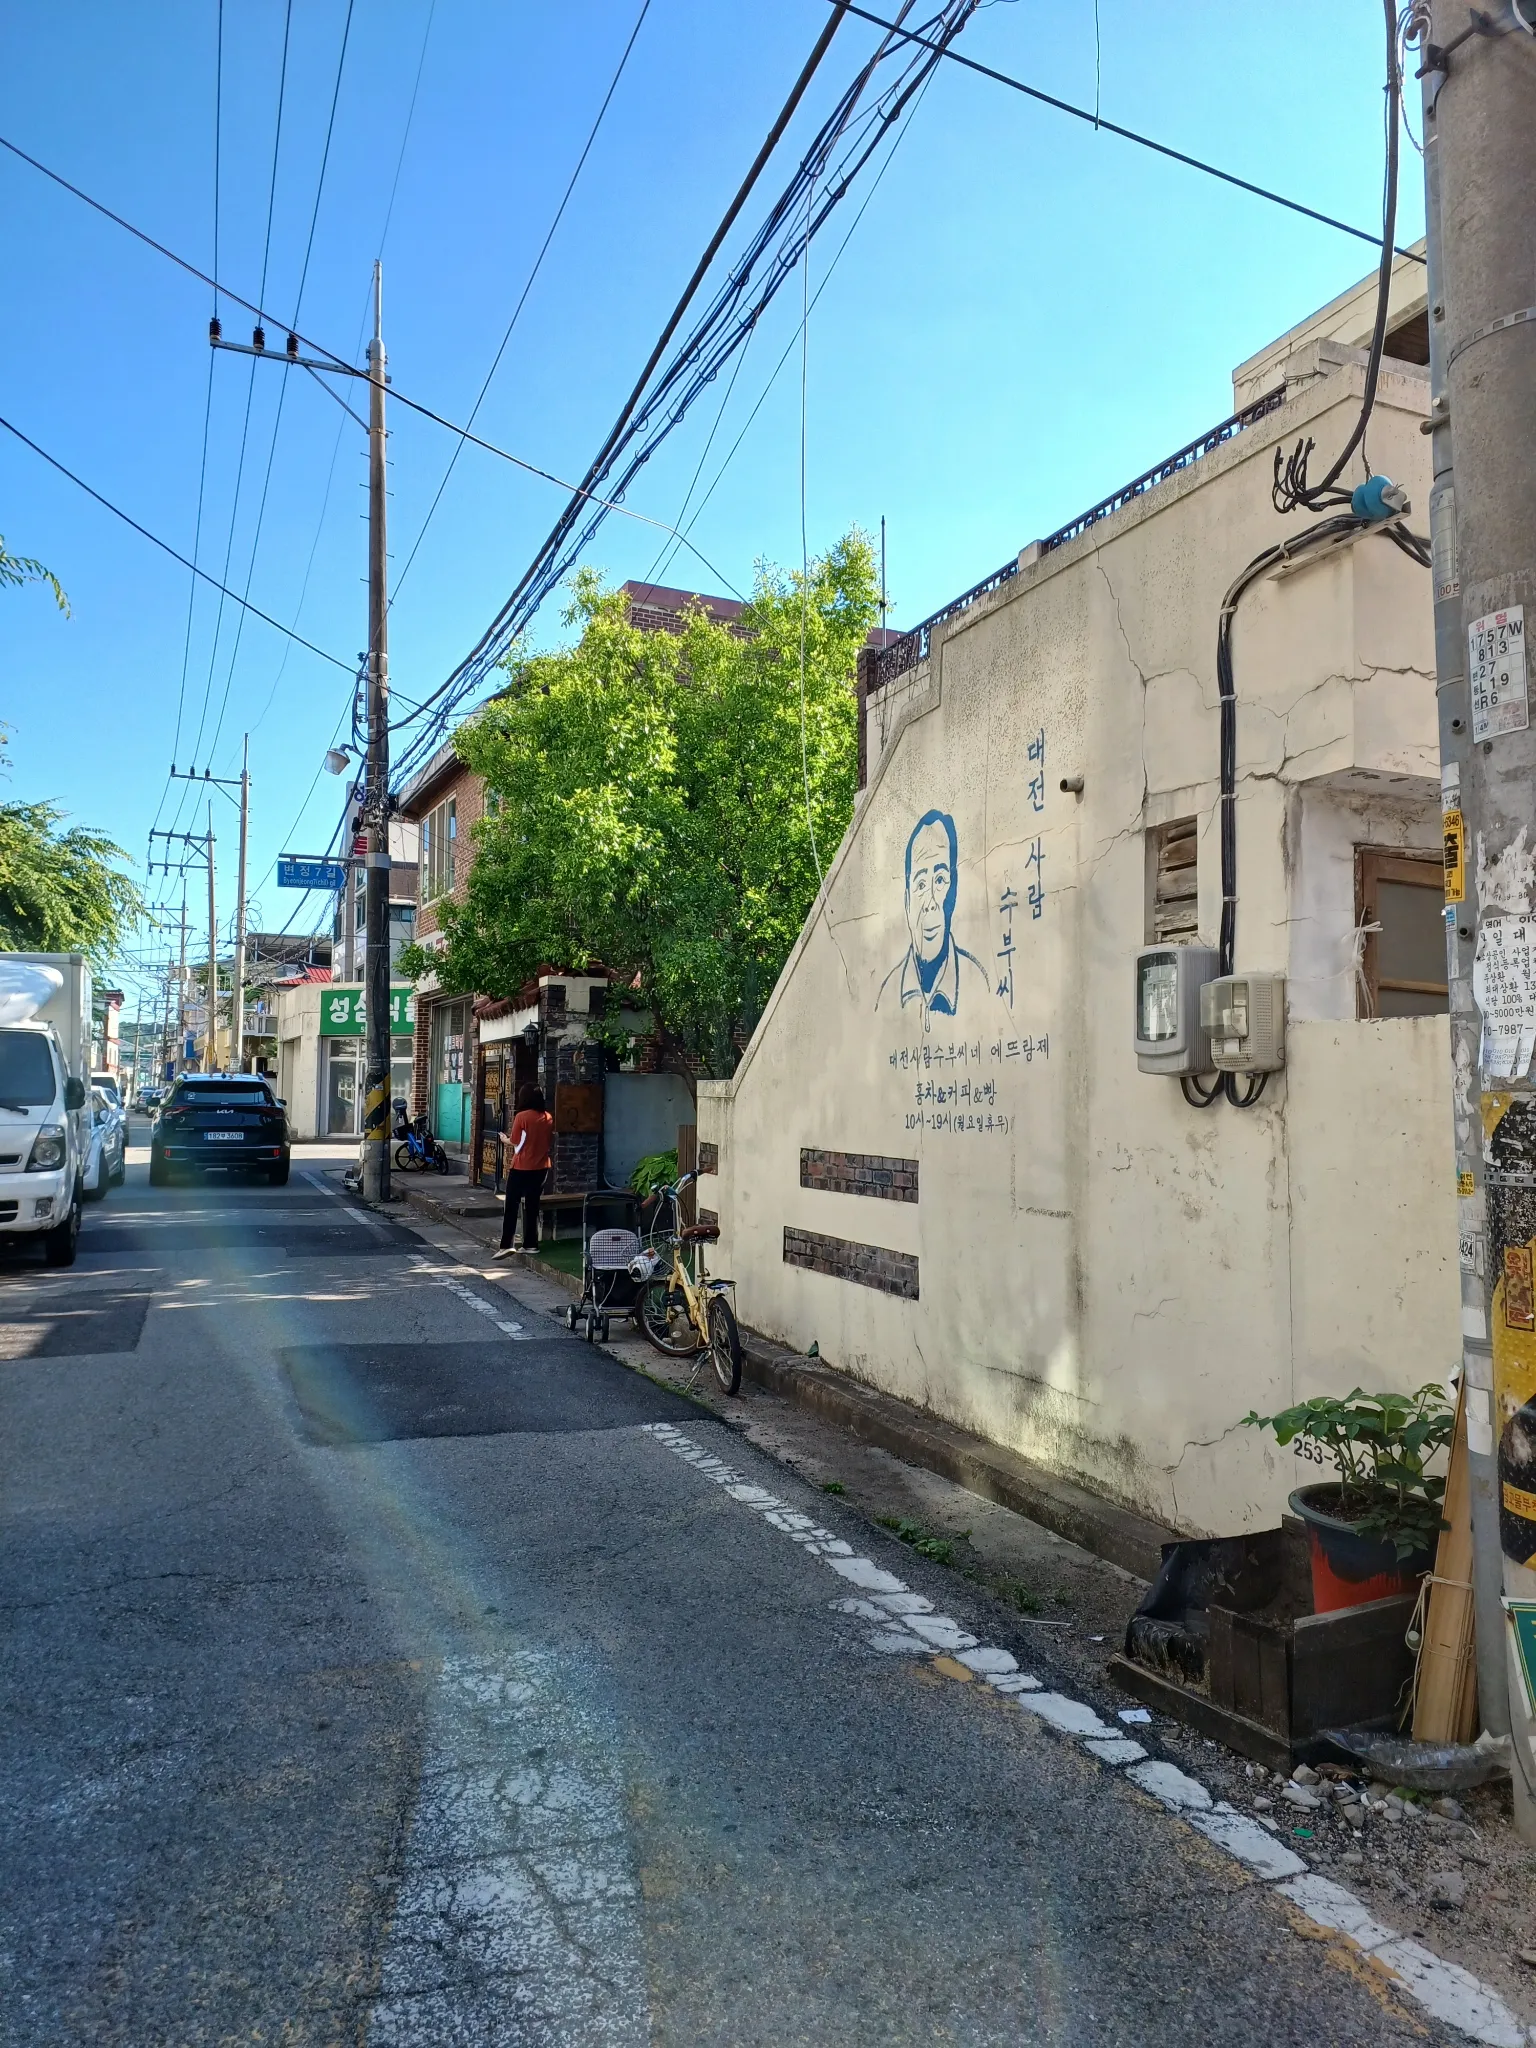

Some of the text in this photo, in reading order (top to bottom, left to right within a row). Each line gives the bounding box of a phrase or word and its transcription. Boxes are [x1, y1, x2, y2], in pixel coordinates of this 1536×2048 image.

[1471, 621, 1522, 651] 1757W
[1026, 728, 1045, 812] 대전
[1025, 837, 1046, 920] 사람
[1502, 994, 1523, 1005] 100%
[889, 1033, 1049, 1070] 대전사람수부씨네 에뜨랑제
[915, 1078, 997, 1106] 홍차&커피&빵
